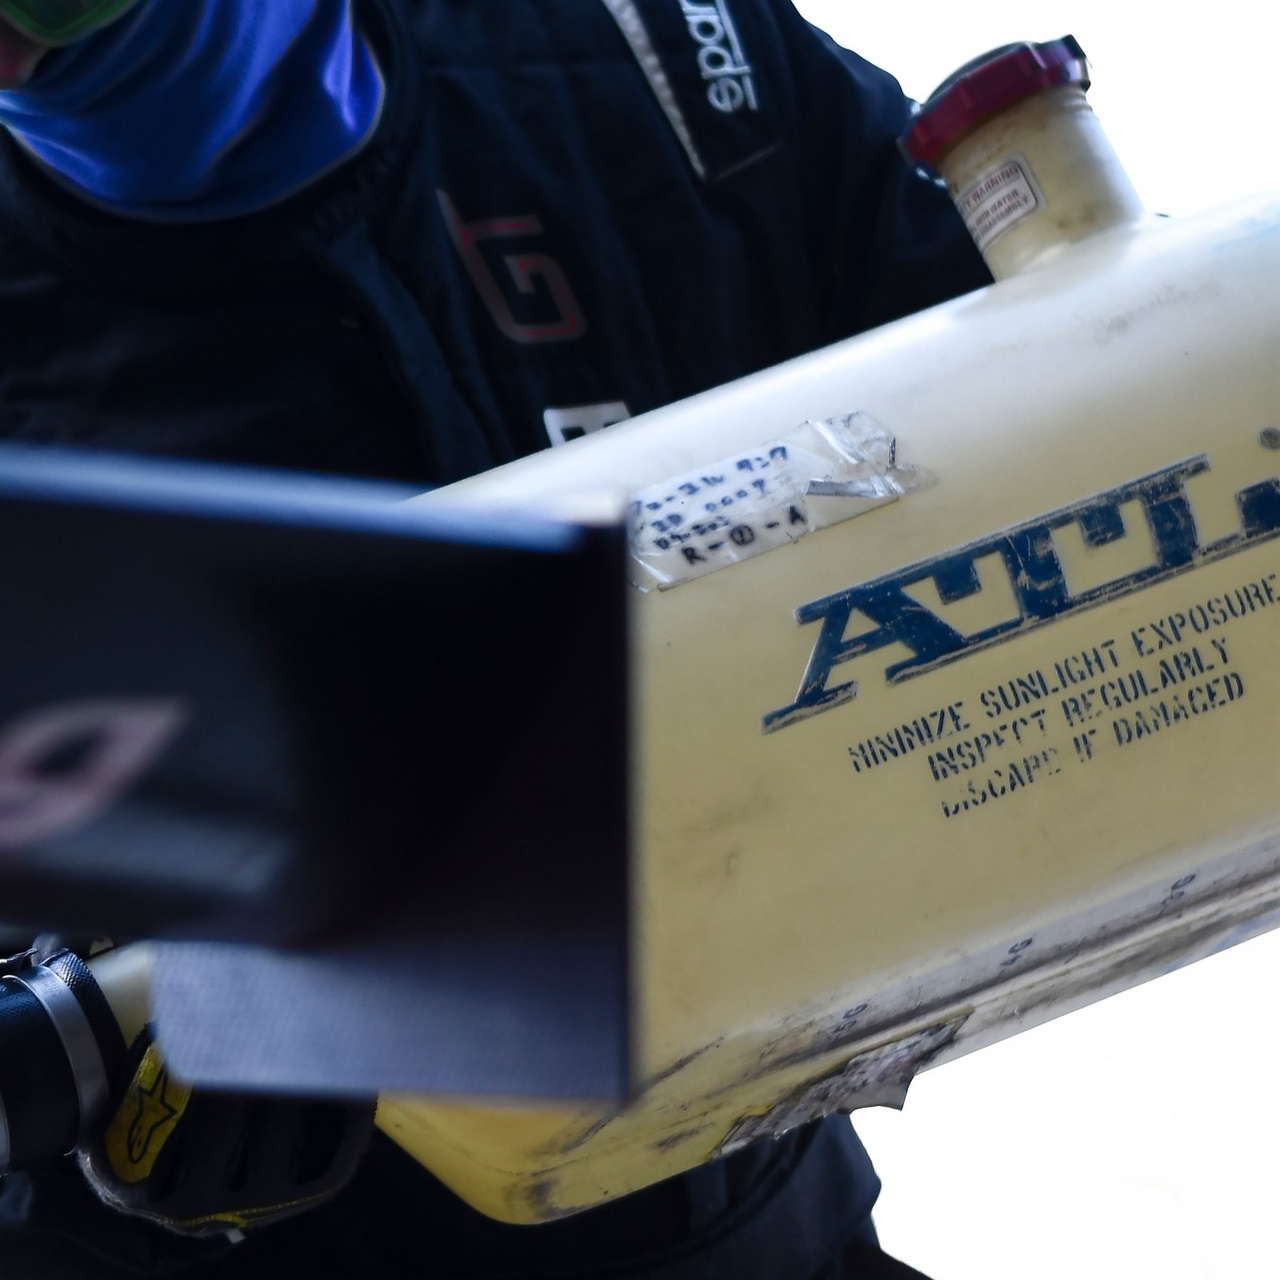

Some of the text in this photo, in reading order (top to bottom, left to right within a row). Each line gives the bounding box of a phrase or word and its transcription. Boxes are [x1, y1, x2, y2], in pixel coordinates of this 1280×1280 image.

[760, 452, 1280, 735] ATL
[847, 573, 1280, 773] MINIMIZE SUNLIGHT EXPOSURE
[926, 637, 1231, 782] INSPECT REGULARLY
[1072, 728, 1099, 765] IF
[1112, 671, 1246, 747] DAMAGED
